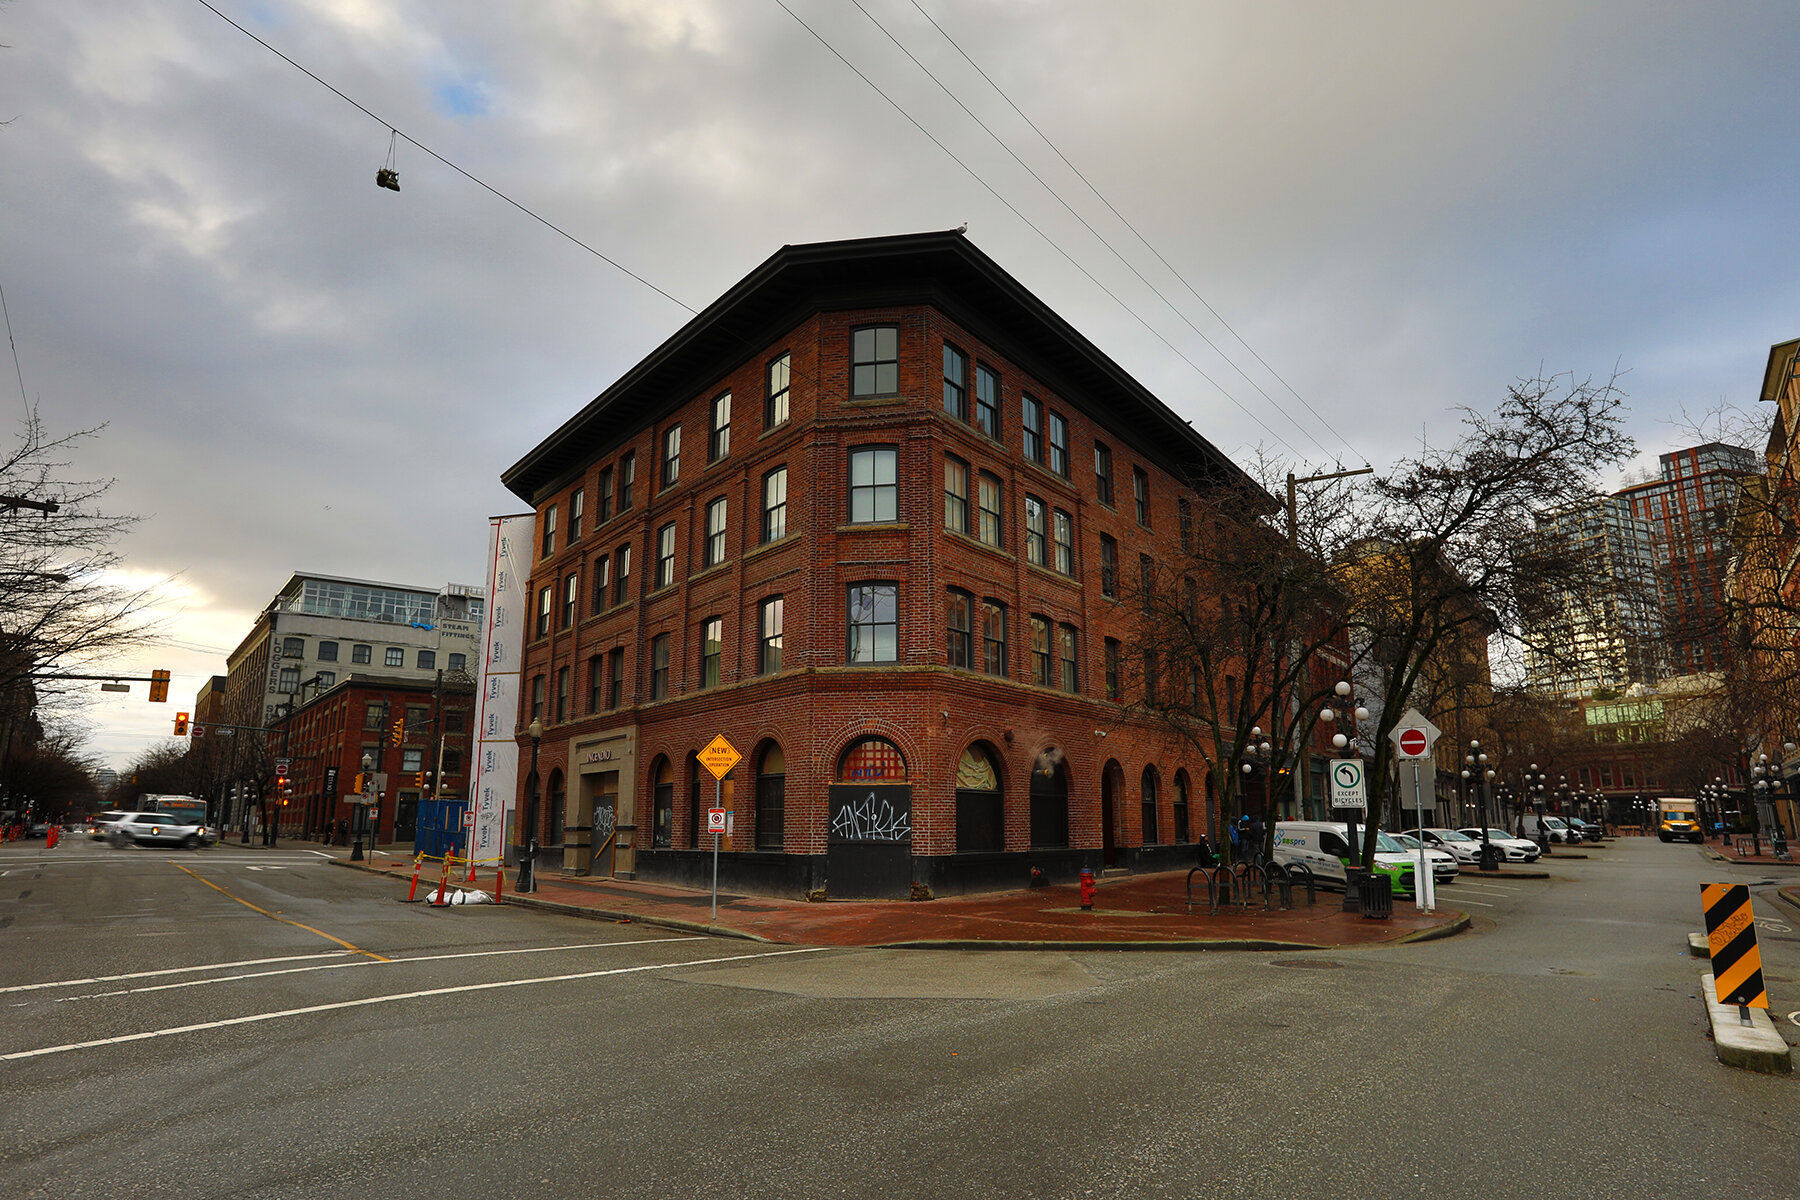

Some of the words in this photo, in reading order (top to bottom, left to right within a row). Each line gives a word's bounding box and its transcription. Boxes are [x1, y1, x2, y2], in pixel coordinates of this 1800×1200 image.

[442, 623, 469, 631] STEAM
[494, 606, 502, 628] Tyvek
[441, 631, 475, 639] FITTINGS
[492, 641, 500, 663] Tyvek
[268, 637, 282, 694] LOGGERS
[489, 677, 498, 700] Tyvek
[487, 713, 496, 736] Tyvek
[484, 750, 493, 773] Tyvek
[482, 786, 491, 810] Tyvek
[479, 825, 488, 849] Tyvek
